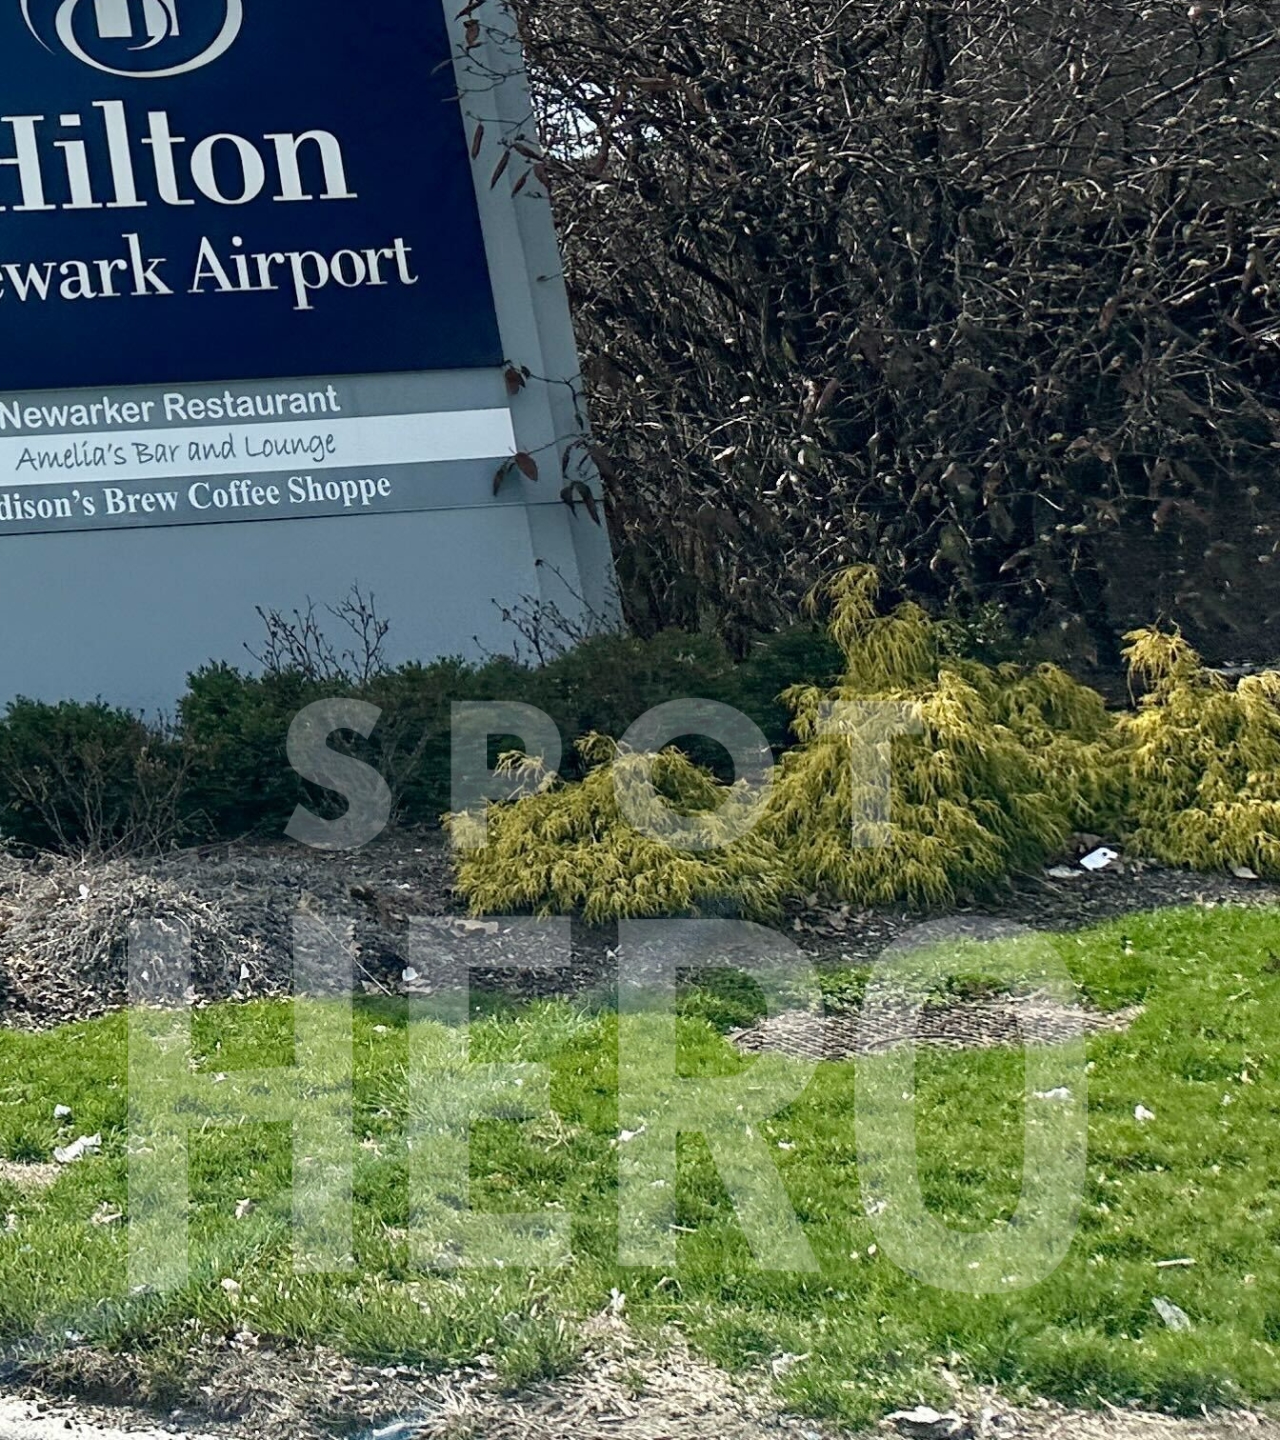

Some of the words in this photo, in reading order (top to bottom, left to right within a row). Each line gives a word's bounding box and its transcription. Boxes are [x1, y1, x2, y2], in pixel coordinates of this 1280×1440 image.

[187, 236, 419, 310] Airport
[163, 384, 341, 421] Restaurant
[15, 440, 128, 471] Amelia's
[131, 442, 179, 464] Bar
[188, 432, 236, 459] and
[245, 432, 337, 462] Lounge
[103, 487, 179, 515] Brew
[188, 479, 281, 509] Coffee
[286, 475, 392, 508] Shoppe
